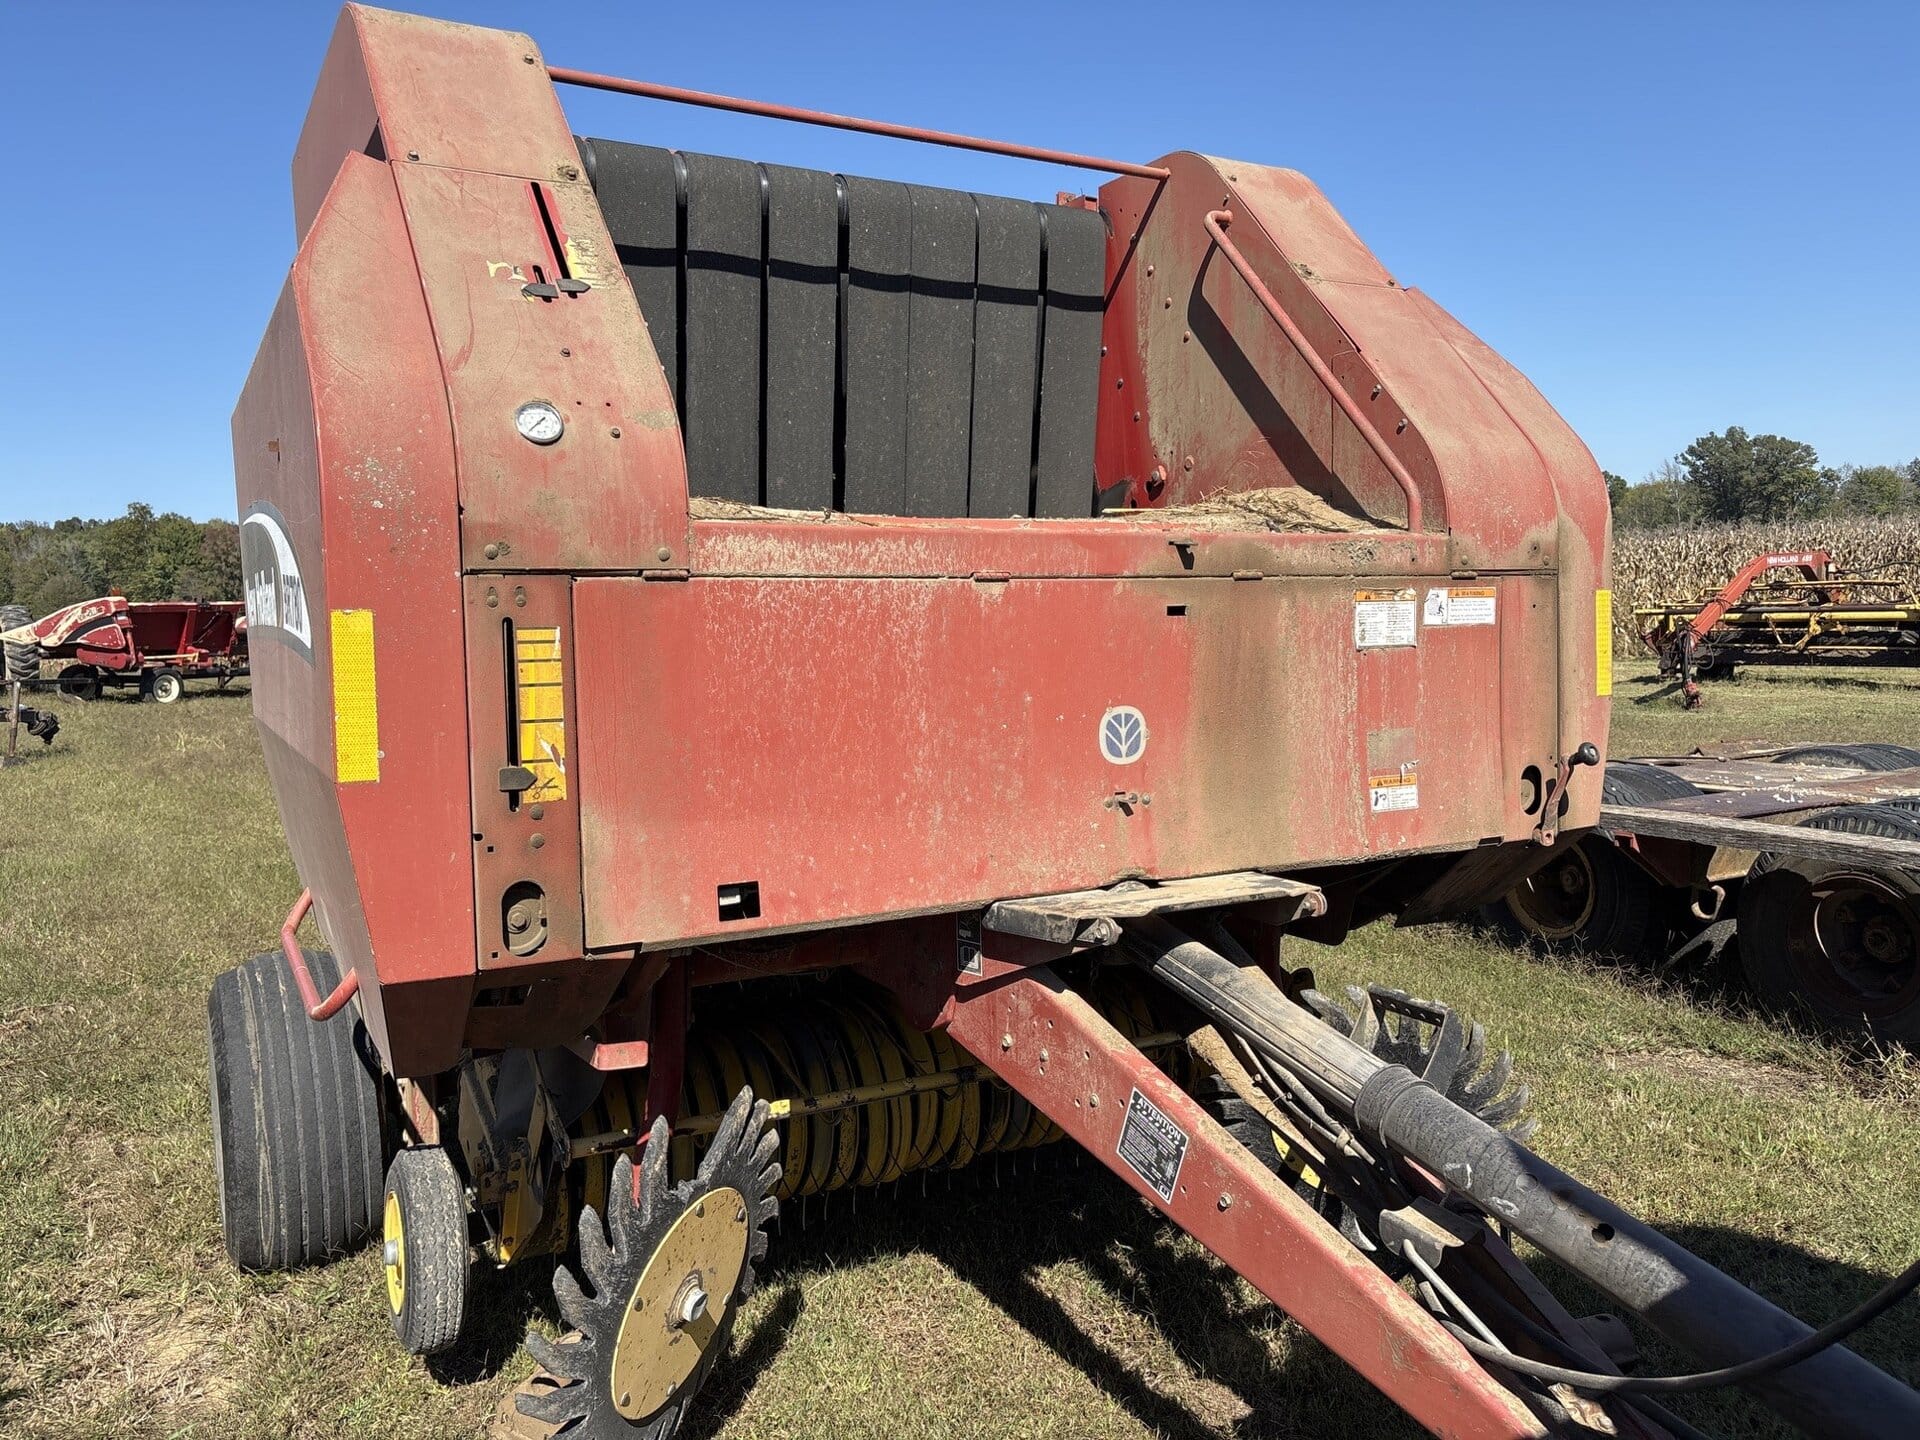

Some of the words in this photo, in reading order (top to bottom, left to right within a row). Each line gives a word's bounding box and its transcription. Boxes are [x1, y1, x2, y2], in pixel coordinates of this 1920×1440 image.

[1767, 556, 1777, 564] NEW
[1778, 555, 1798, 563] HOLLAND
[1383, 777, 1411, 785] WARNNG
[1137, 1097, 1182, 1141] ATTENTION
